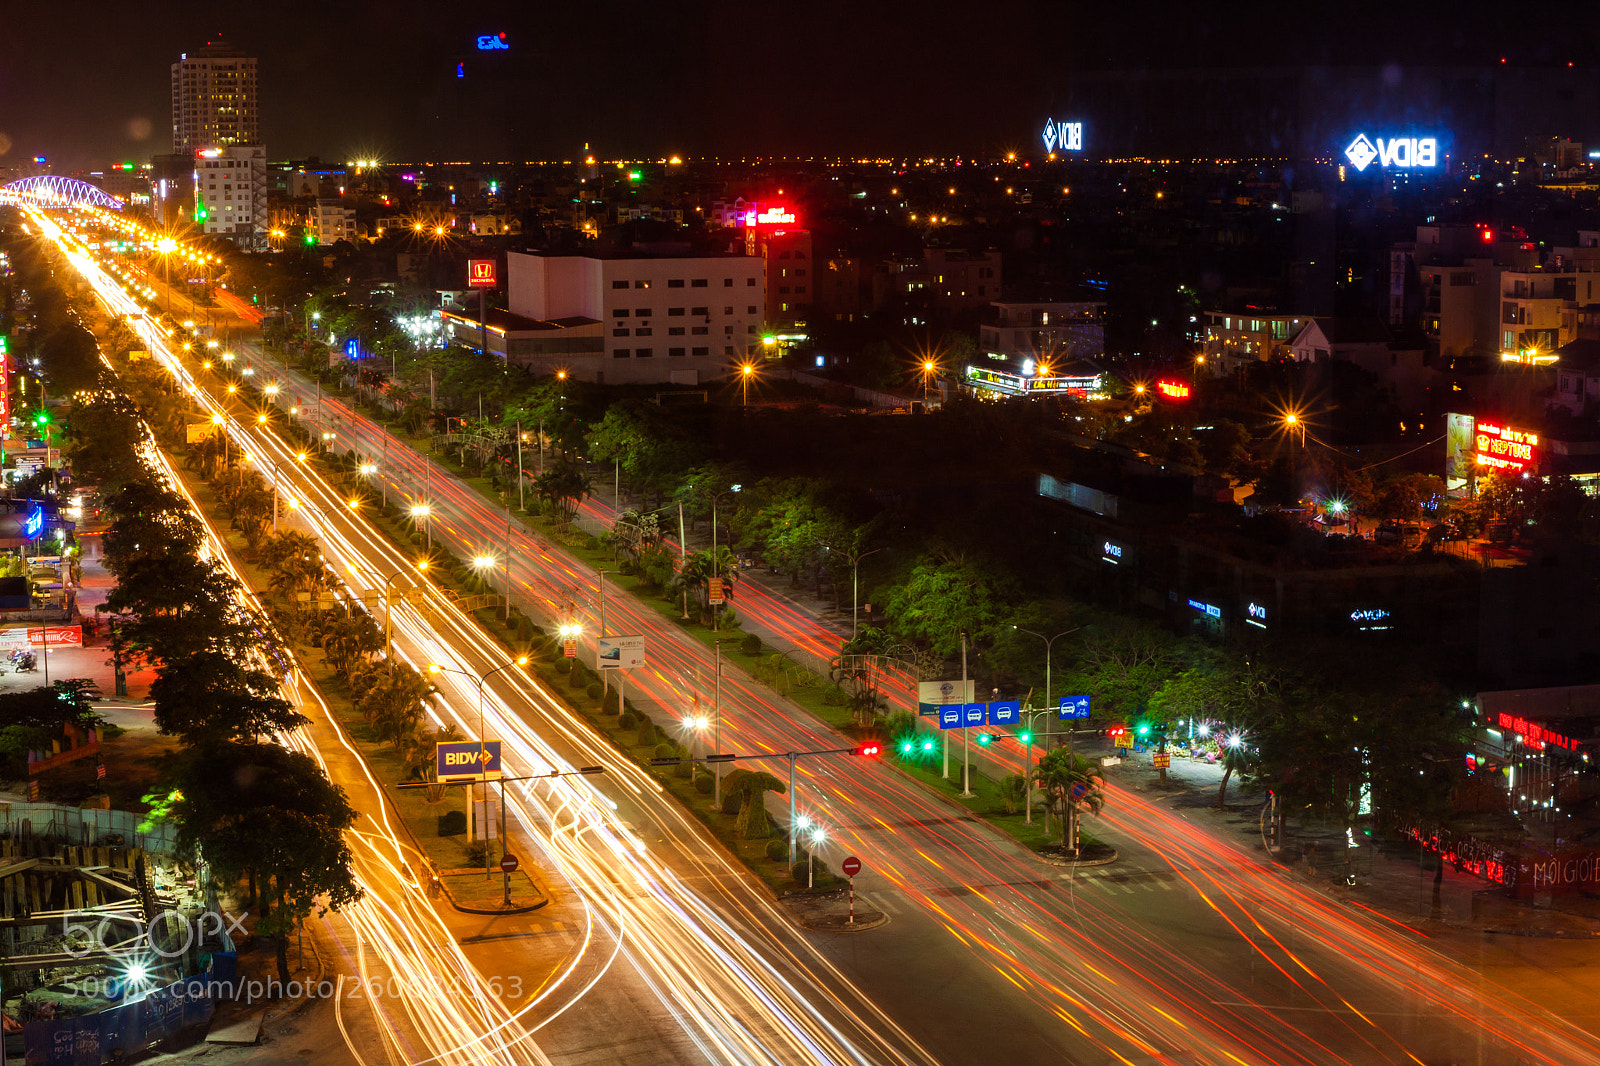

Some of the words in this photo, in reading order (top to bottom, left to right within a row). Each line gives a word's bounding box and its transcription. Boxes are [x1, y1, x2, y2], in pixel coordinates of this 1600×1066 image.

[1490, 438, 1532, 460] NEPTUNE
[446, 751, 479, 765] BIDV
[1534, 857, 1561, 888] MÔI
